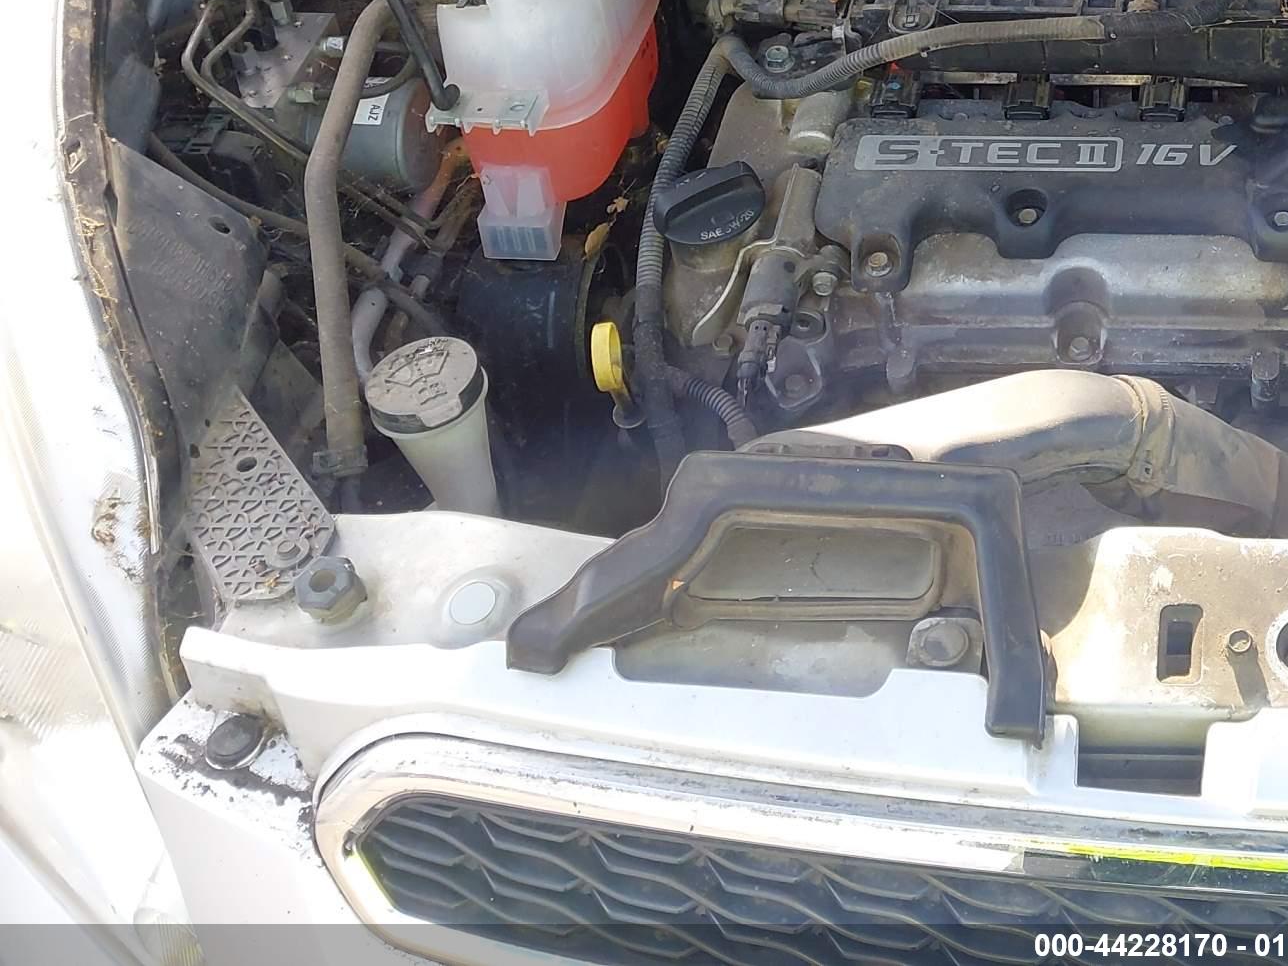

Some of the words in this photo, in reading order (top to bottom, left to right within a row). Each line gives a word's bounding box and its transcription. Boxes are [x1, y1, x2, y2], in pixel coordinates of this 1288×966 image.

[367, 104, 381, 122] AJZ
[1134, 143, 1238, 166] 16V
[700, 227, 724, 241] SAE
